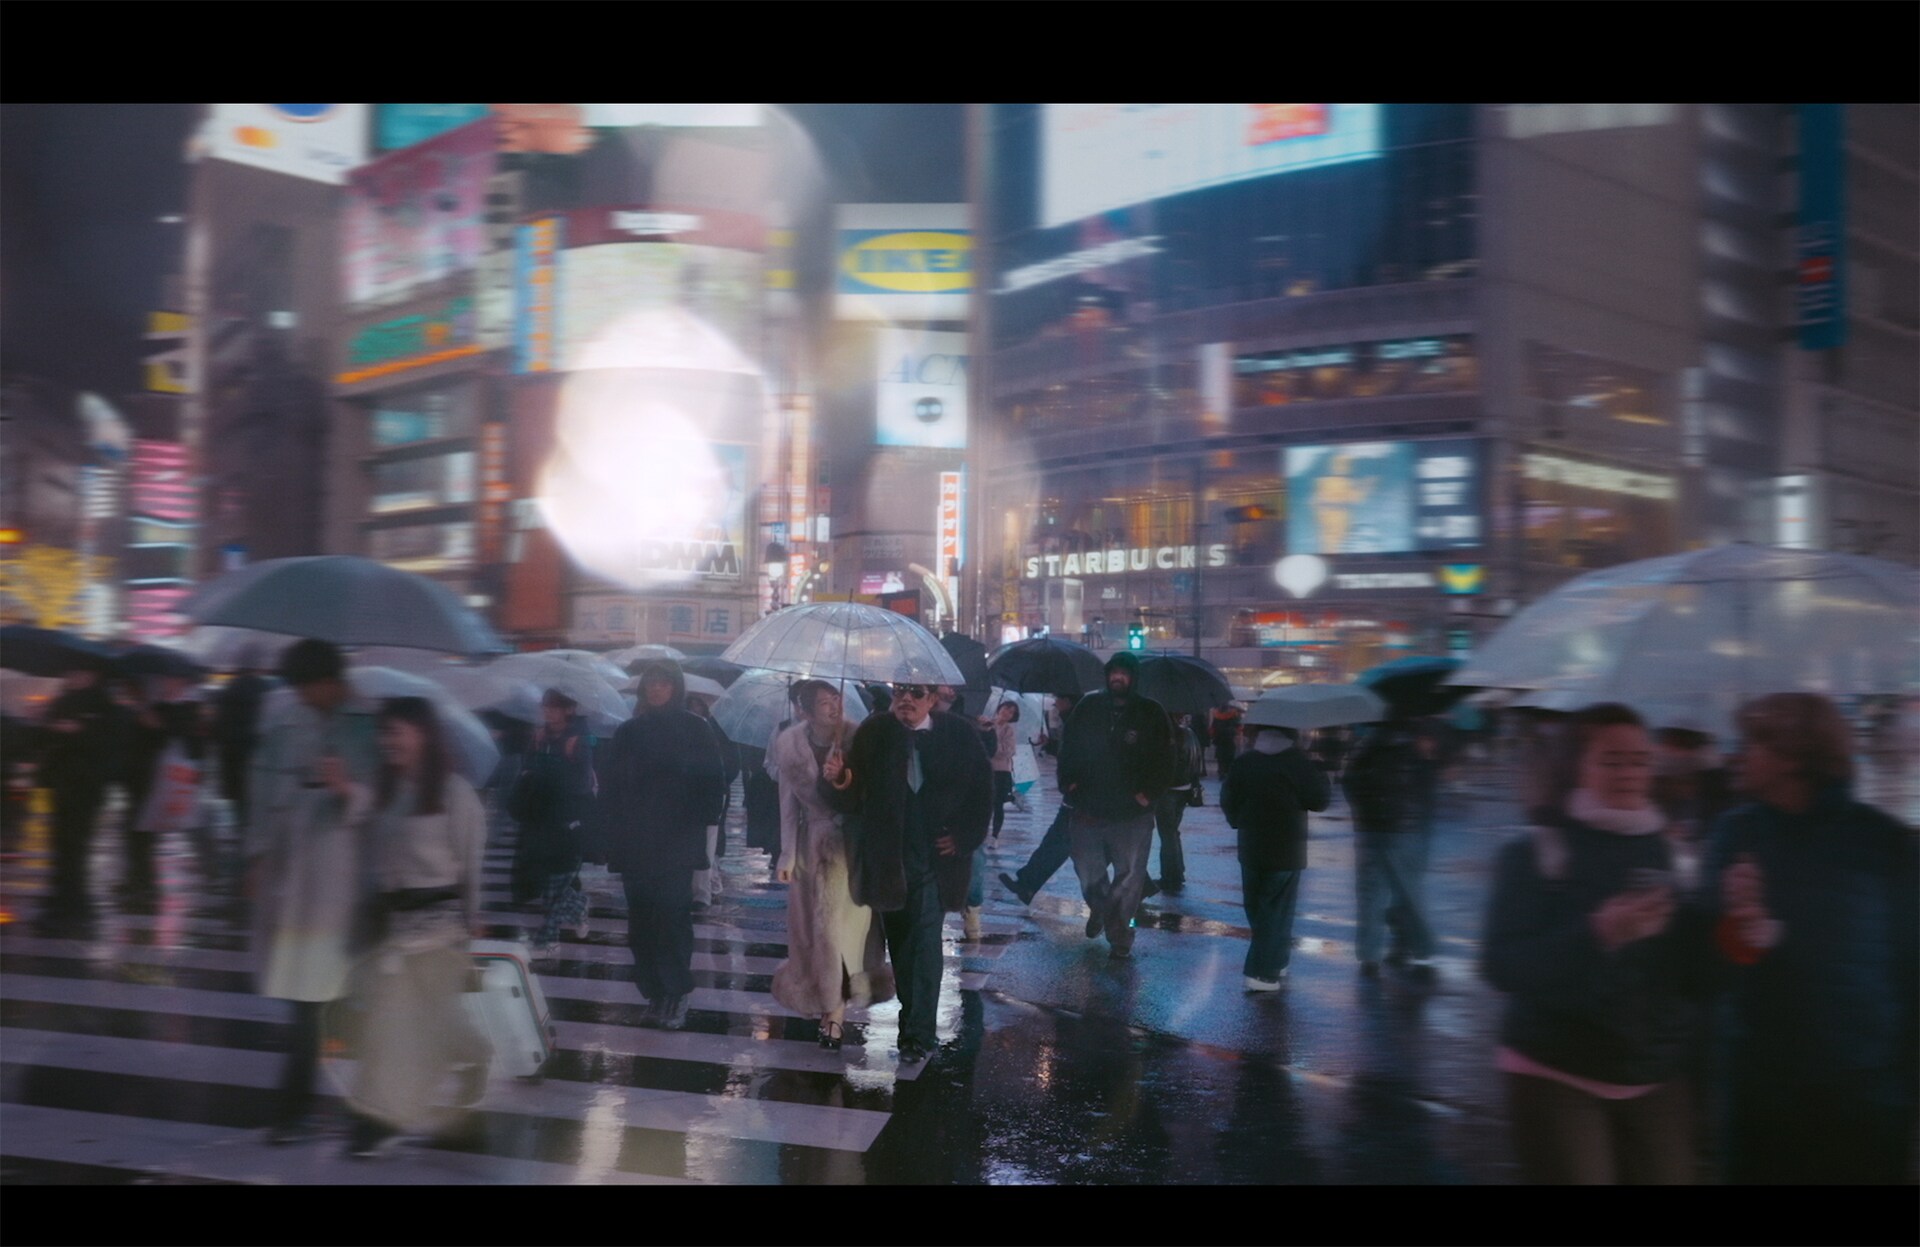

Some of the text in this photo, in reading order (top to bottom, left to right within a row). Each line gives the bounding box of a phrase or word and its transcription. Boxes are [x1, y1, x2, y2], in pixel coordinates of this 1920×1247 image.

[943, 482, 957, 566] カラオケ
[638, 540, 740, 577] DMM
[1026, 544, 1226, 578] STARBUCKS
